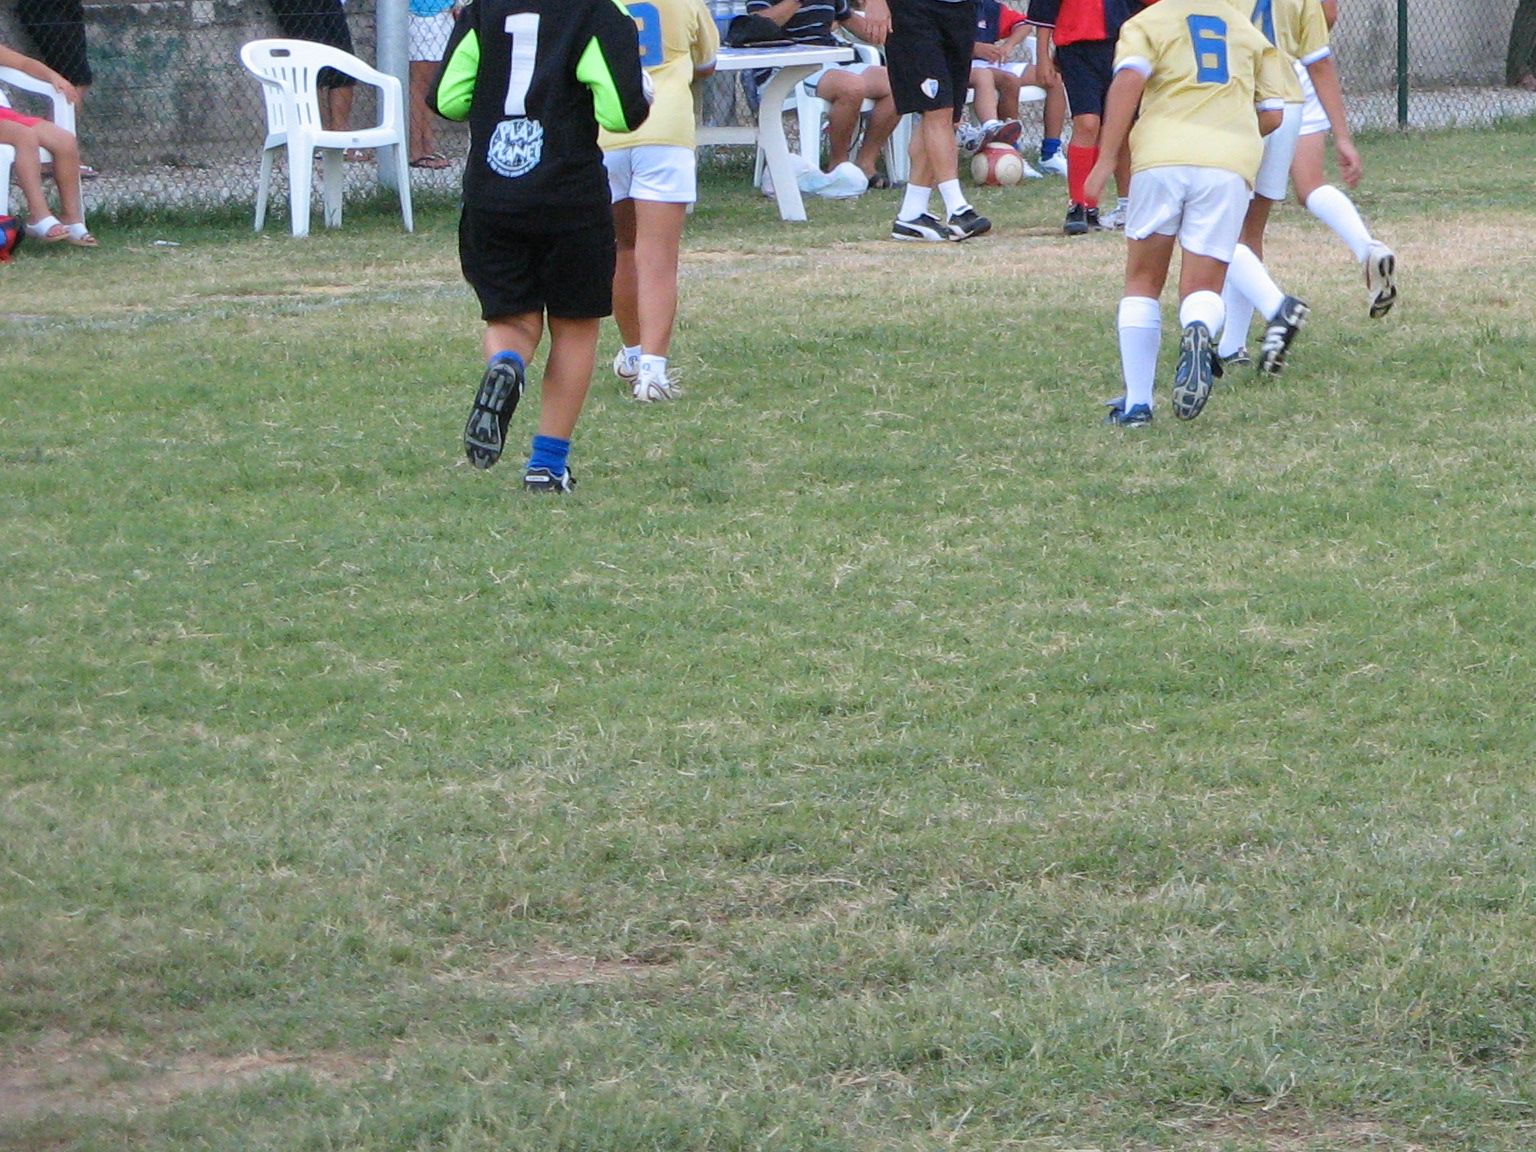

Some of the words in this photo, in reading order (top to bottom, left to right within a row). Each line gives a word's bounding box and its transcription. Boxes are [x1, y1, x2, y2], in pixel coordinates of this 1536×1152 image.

[505, 12, 540, 115] 1
[1186, 14, 1230, 84] 6
[491, 139, 543, 166] PLANET
[499, 119, 543, 143] PLAY
